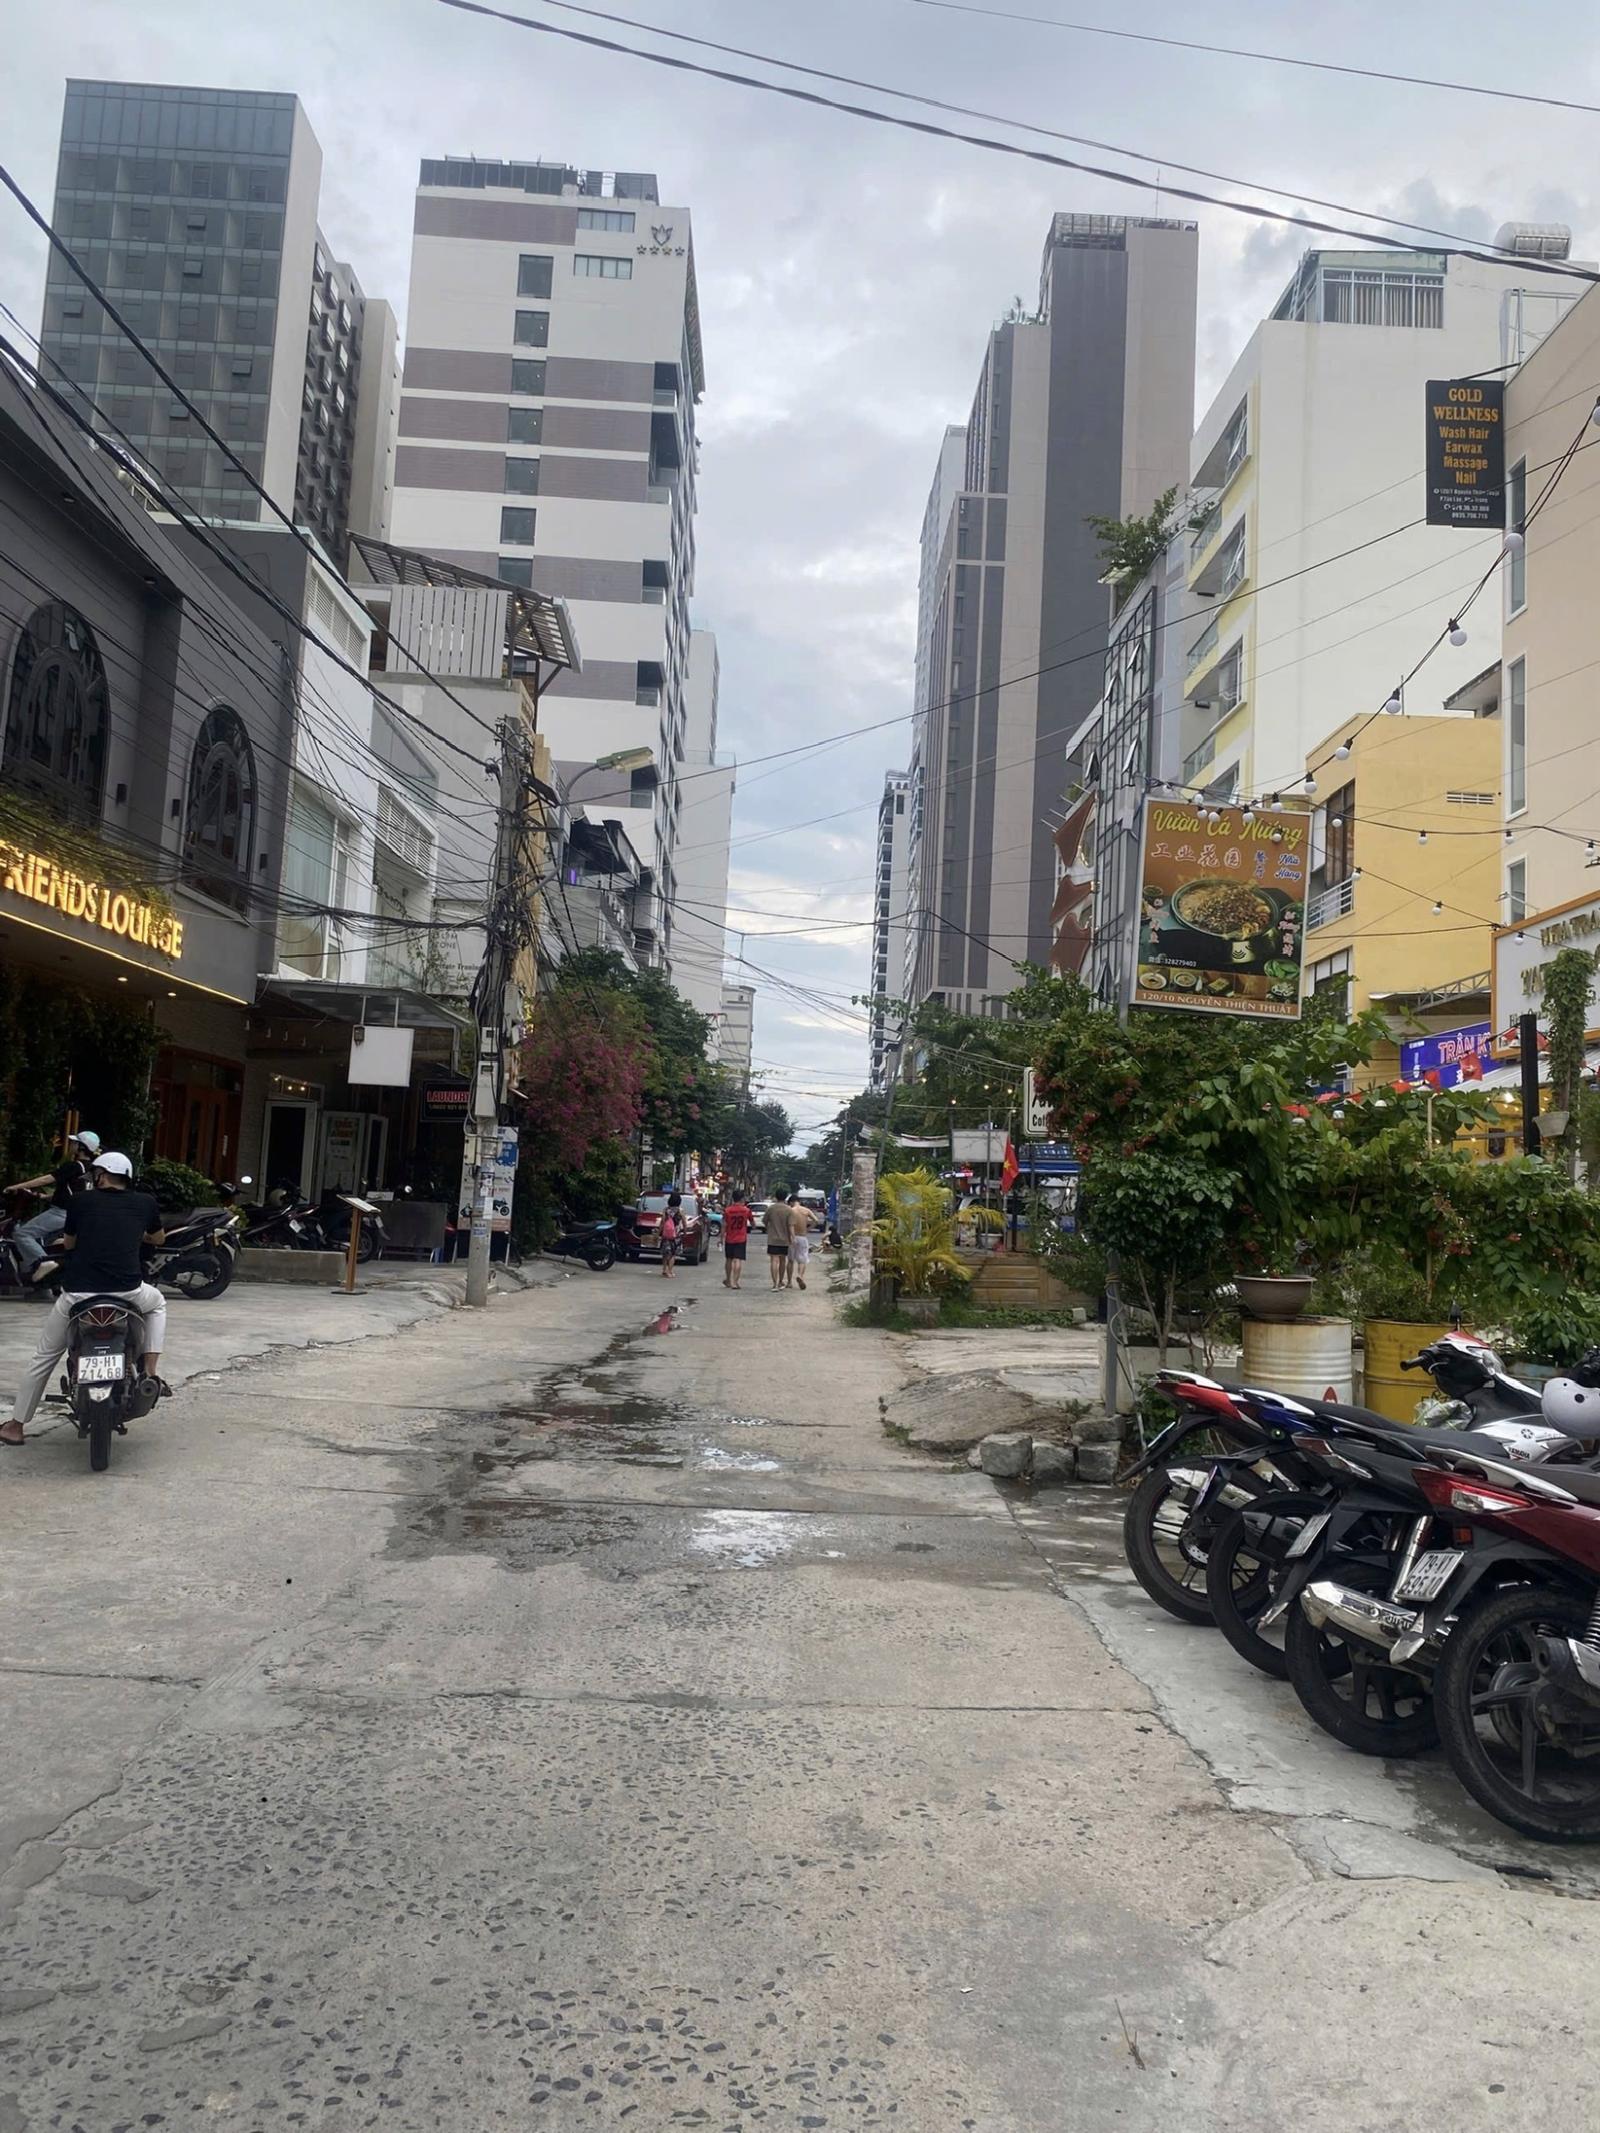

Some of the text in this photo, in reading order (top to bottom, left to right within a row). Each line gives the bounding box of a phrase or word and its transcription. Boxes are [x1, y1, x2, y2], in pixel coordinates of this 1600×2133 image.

[1448, 388, 1483, 402] GOLD
[1433, 406, 1499, 422] WELLNESS
[1439, 426, 1490, 439] Wash Hair
[1445, 441, 1483, 454] Earwax
[1443, 456, 1489, 470] Massage
[1456, 471, 1477, 484] Nail
[1207, 816, 1232, 837] Cá
[1142, 991, 1174, 1002] 120/10
[85, 1356, 116, 1368] 79-H1
